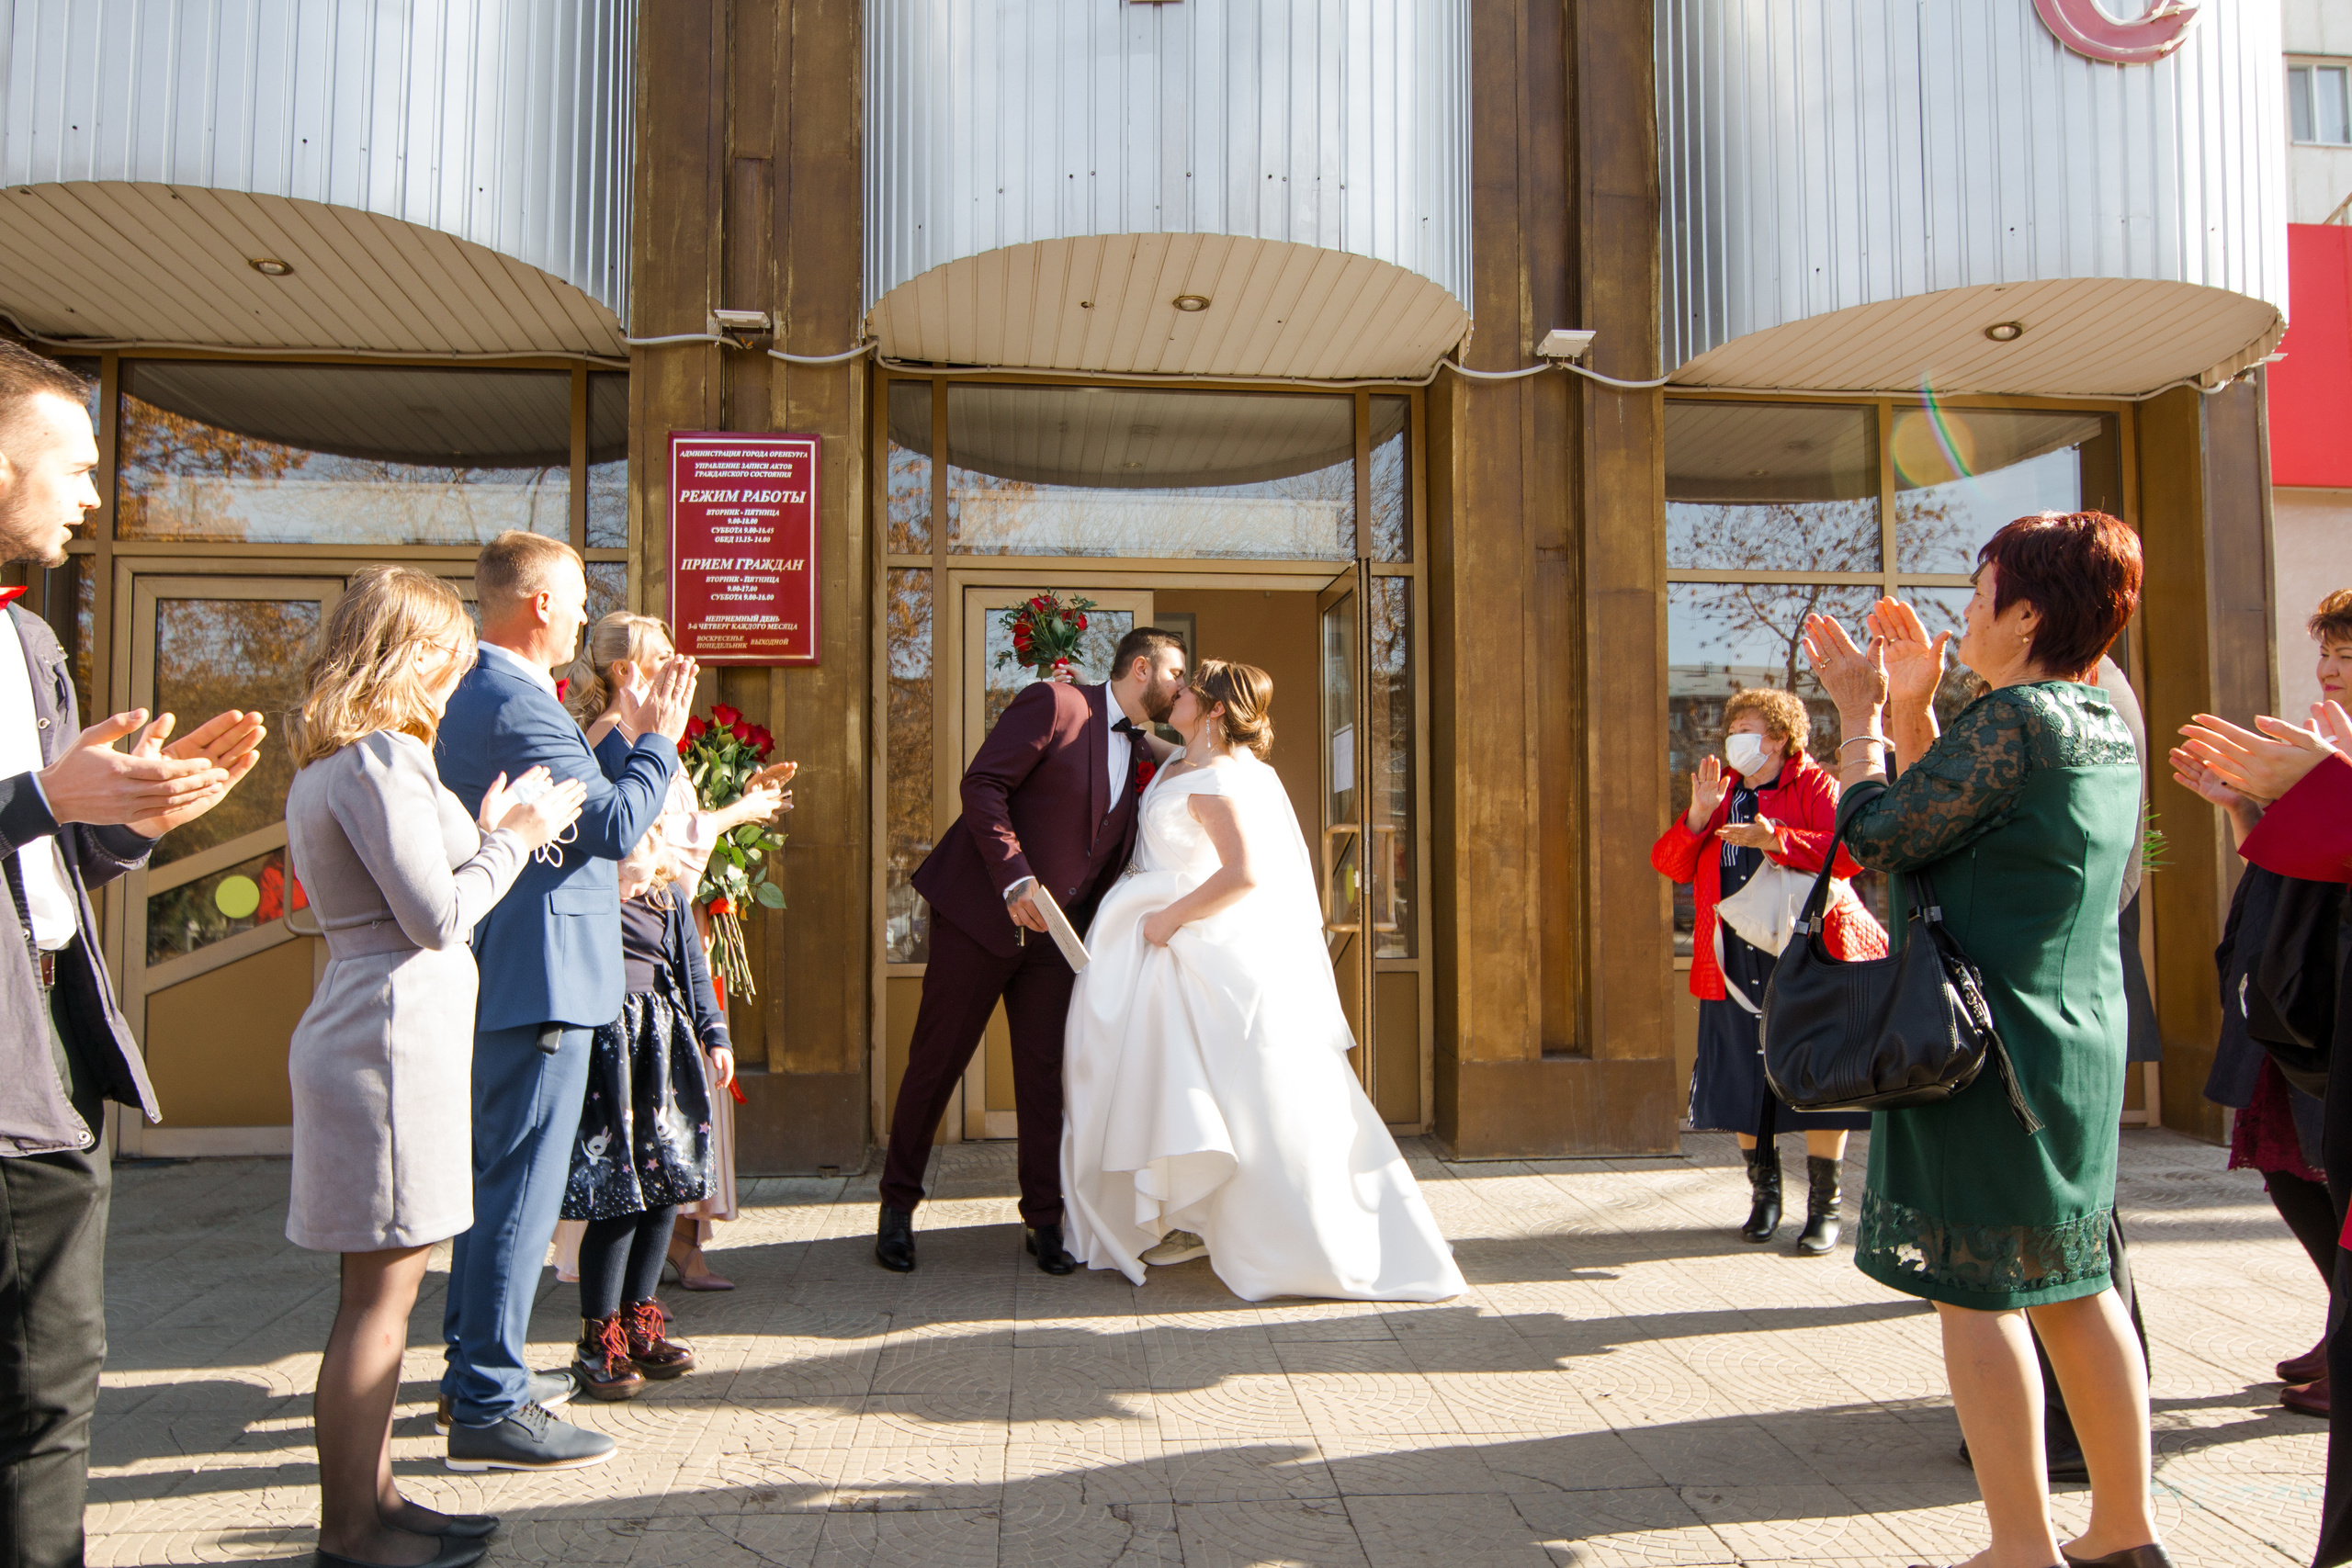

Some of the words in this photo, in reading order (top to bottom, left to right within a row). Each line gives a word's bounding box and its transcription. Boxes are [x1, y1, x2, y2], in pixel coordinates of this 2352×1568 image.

[679, 490, 740, 502] РЕЖИМ
[741, 491, 806, 503] РАБОТЫ
[681, 558, 733, 570] ПРИЕМ
[735, 559, 804, 571] ГРАЖДАН
